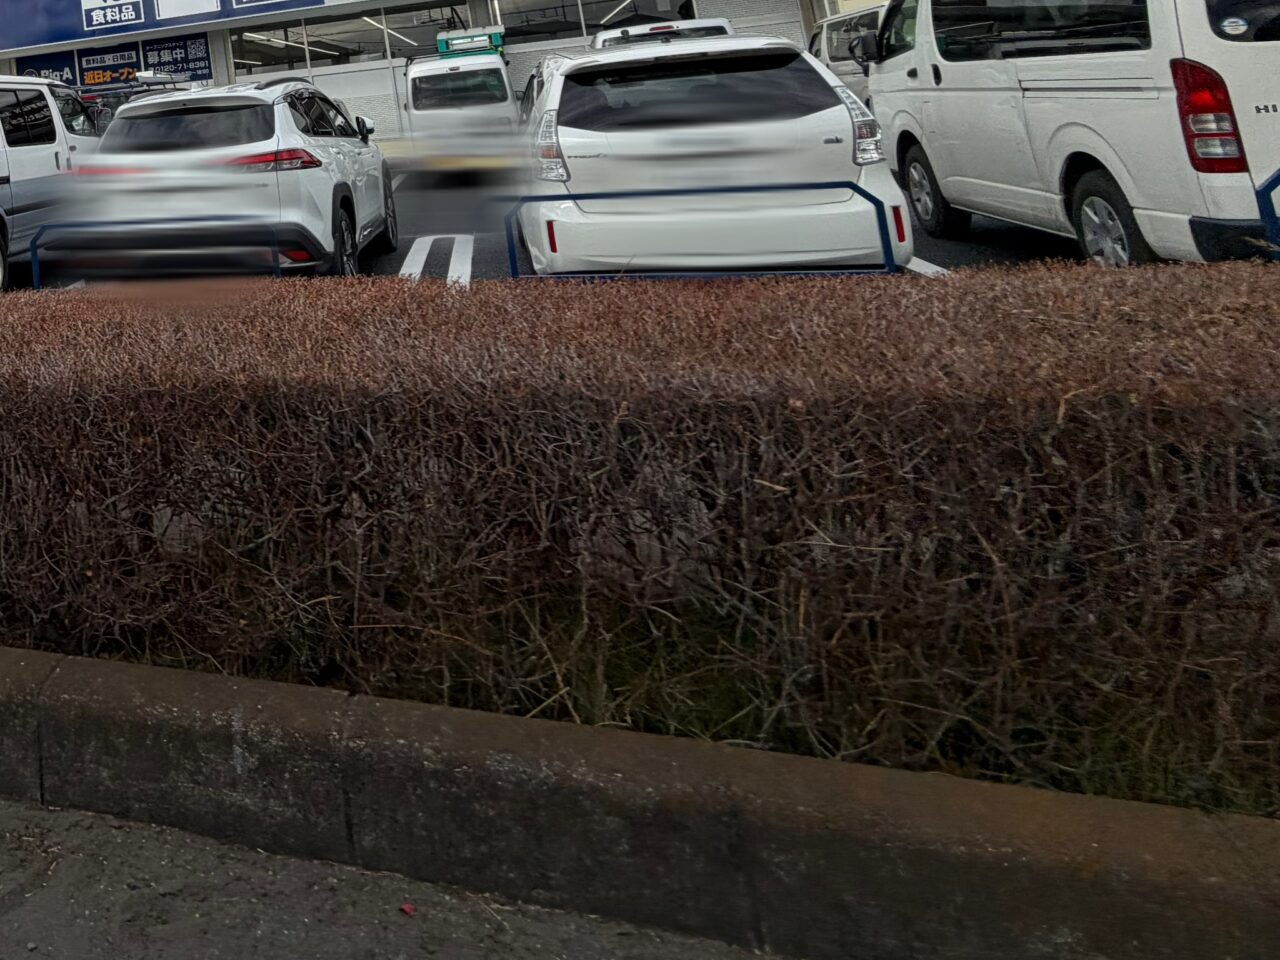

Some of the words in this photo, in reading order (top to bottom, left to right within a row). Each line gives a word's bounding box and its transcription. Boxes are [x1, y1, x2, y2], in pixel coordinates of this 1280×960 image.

[91, 5, 136, 24] 食料品
[146, 48, 185, 64] 募集中
